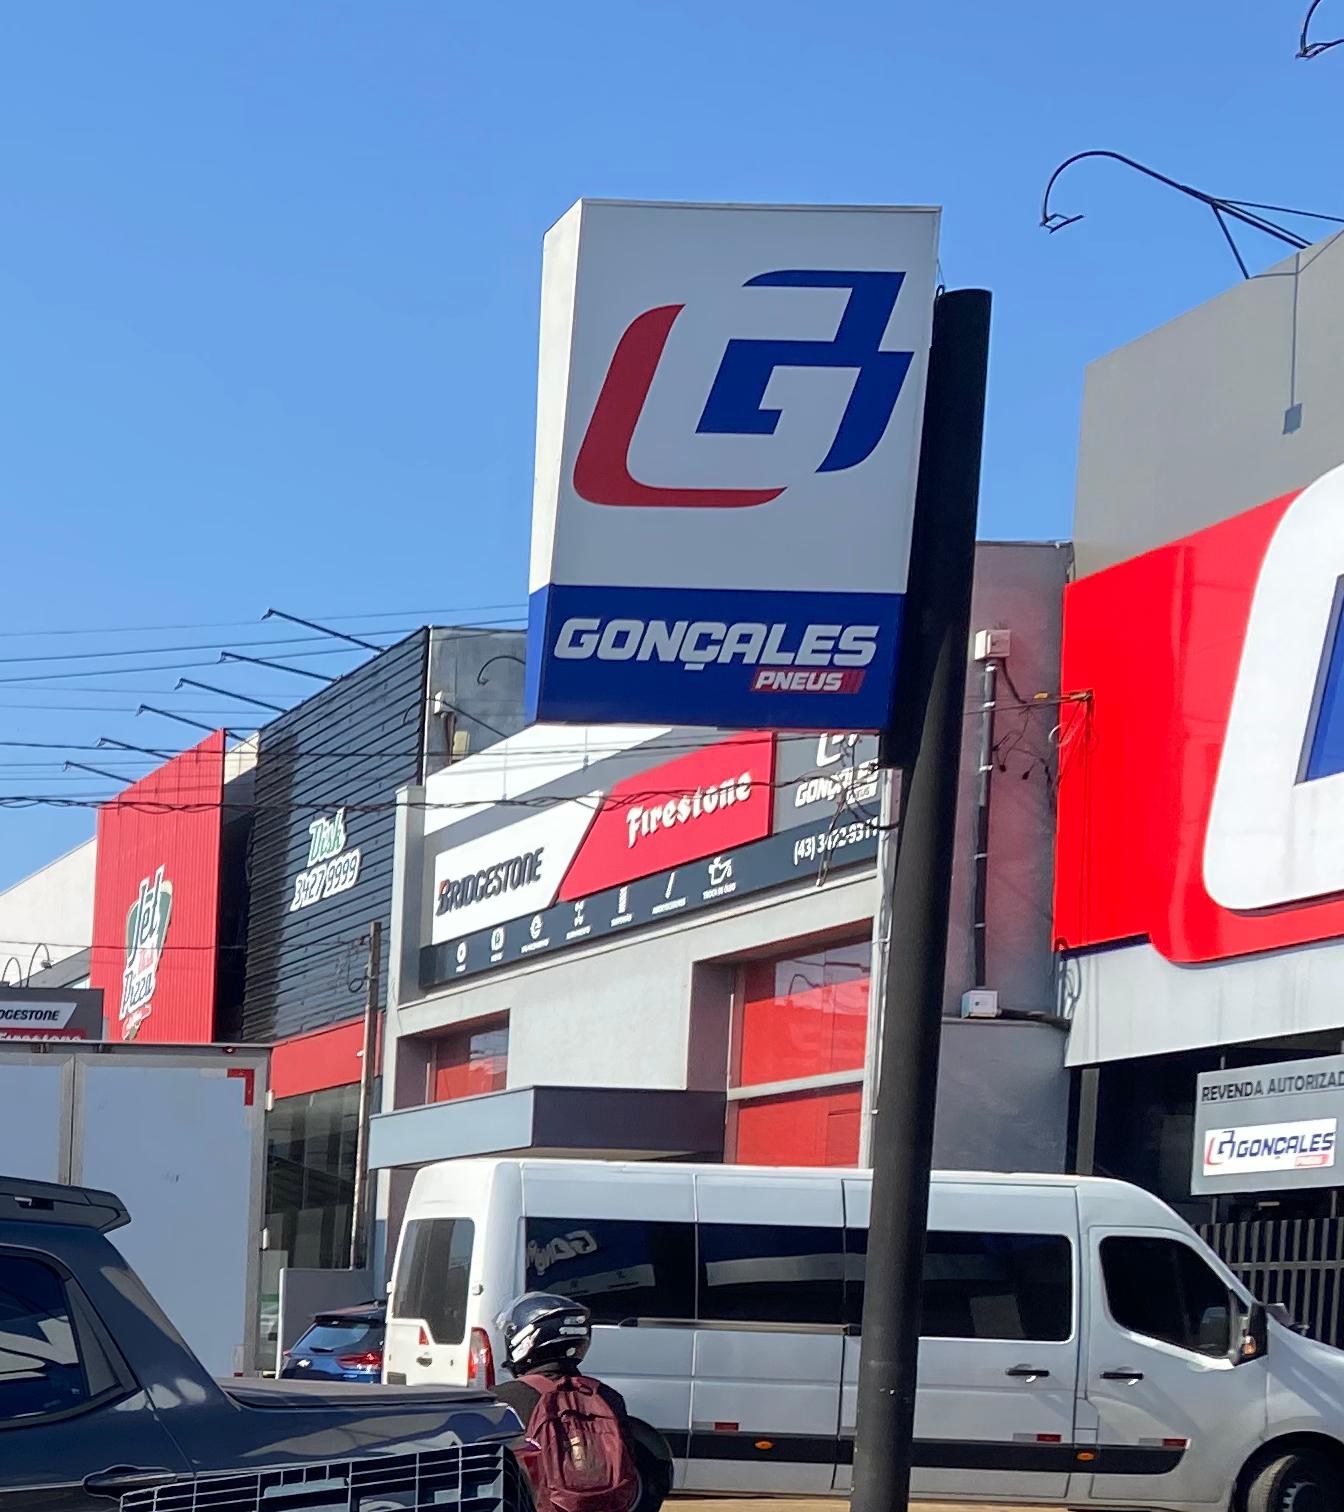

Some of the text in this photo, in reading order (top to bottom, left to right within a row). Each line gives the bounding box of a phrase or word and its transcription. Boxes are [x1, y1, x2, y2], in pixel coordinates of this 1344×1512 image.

[553, 618, 880, 671] GONÇALES
[754, 671, 843, 691] PNEUS
[626, 770, 752, 849] Firestone
[436, 846, 545, 917] BRIDGESTONE
[1201, 1079, 1264, 1102] REVENDA
[1236, 1131, 1336, 1160] GONÇALES
